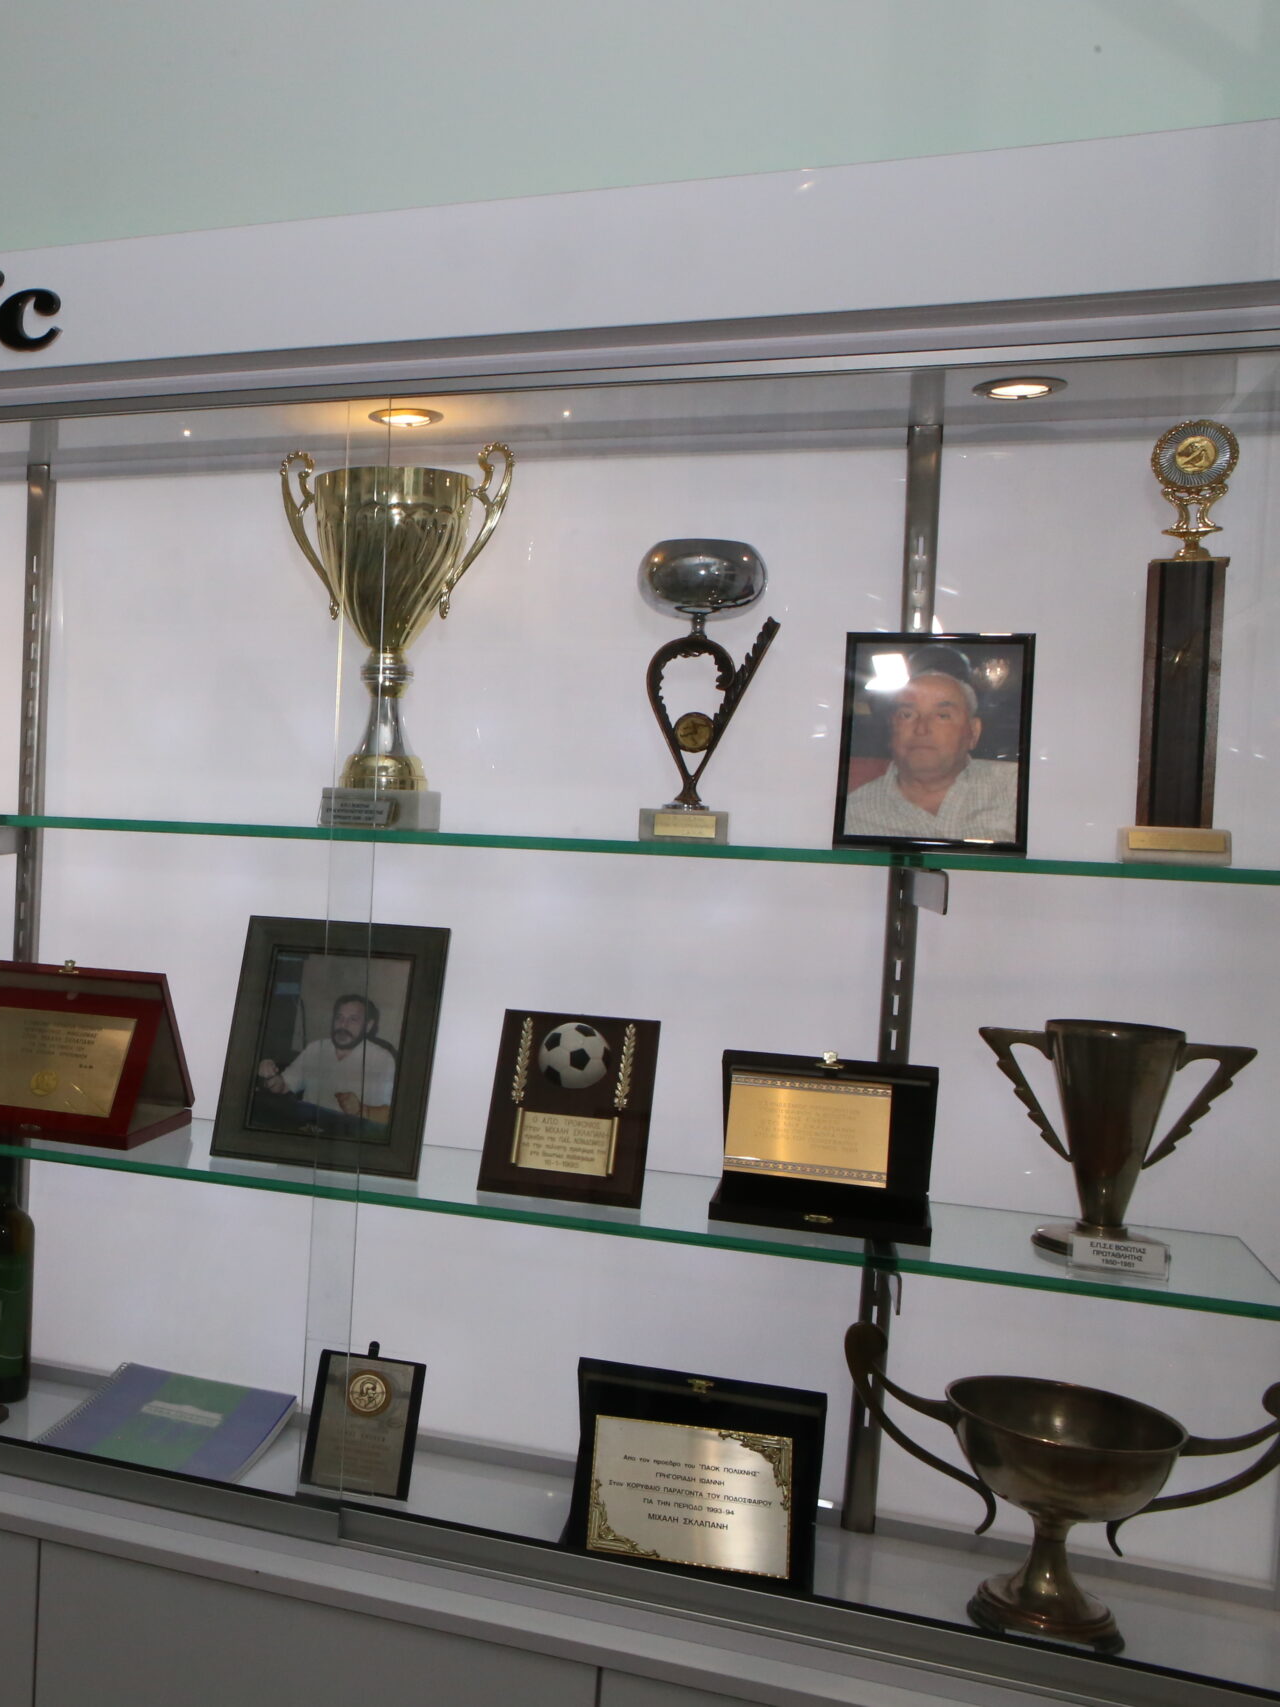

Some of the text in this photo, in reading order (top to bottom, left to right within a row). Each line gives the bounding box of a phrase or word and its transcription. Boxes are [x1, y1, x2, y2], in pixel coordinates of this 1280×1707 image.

[663, 1486, 703, 1497] ΠΑΡΑΓΟΝΤΑ
[723, 1495, 773, 1507] ΠΟΔΟΣΦΑΙΡΟΥ
[673, 1502, 703, 1511] ΠΕΡΙΟΔΟ
[647, 1513, 729, 1530] ΜΙΧΑΛΗ ΣΚΛΑΠΑΝΗ
